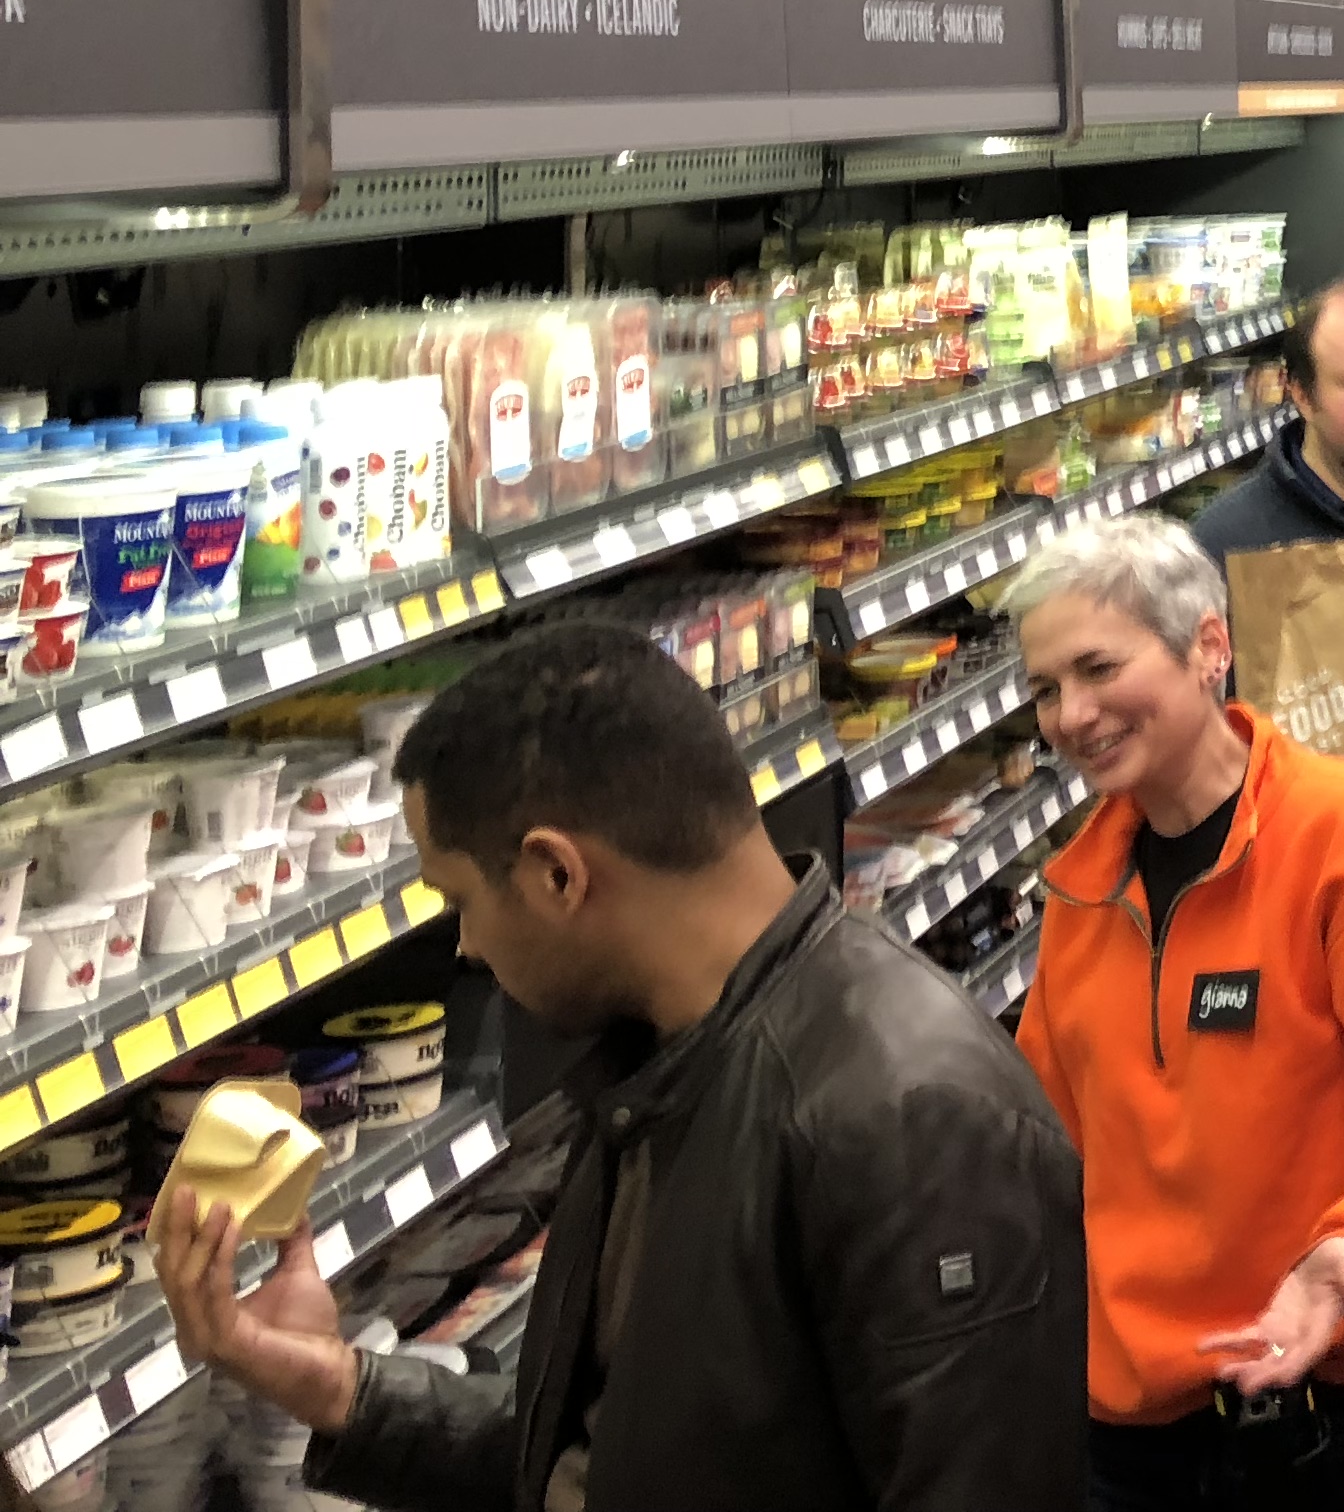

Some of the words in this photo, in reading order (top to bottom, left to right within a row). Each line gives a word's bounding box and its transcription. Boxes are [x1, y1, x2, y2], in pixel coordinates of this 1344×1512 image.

[863, 0, 935, 43] CHARCUTERIE
[943, 3, 974, 44] SNACK
[975, 4, 1004, 44] TRAYS
[387, 449, 406, 544] Chobani
[1199, 979, 1249, 1019] gianna
